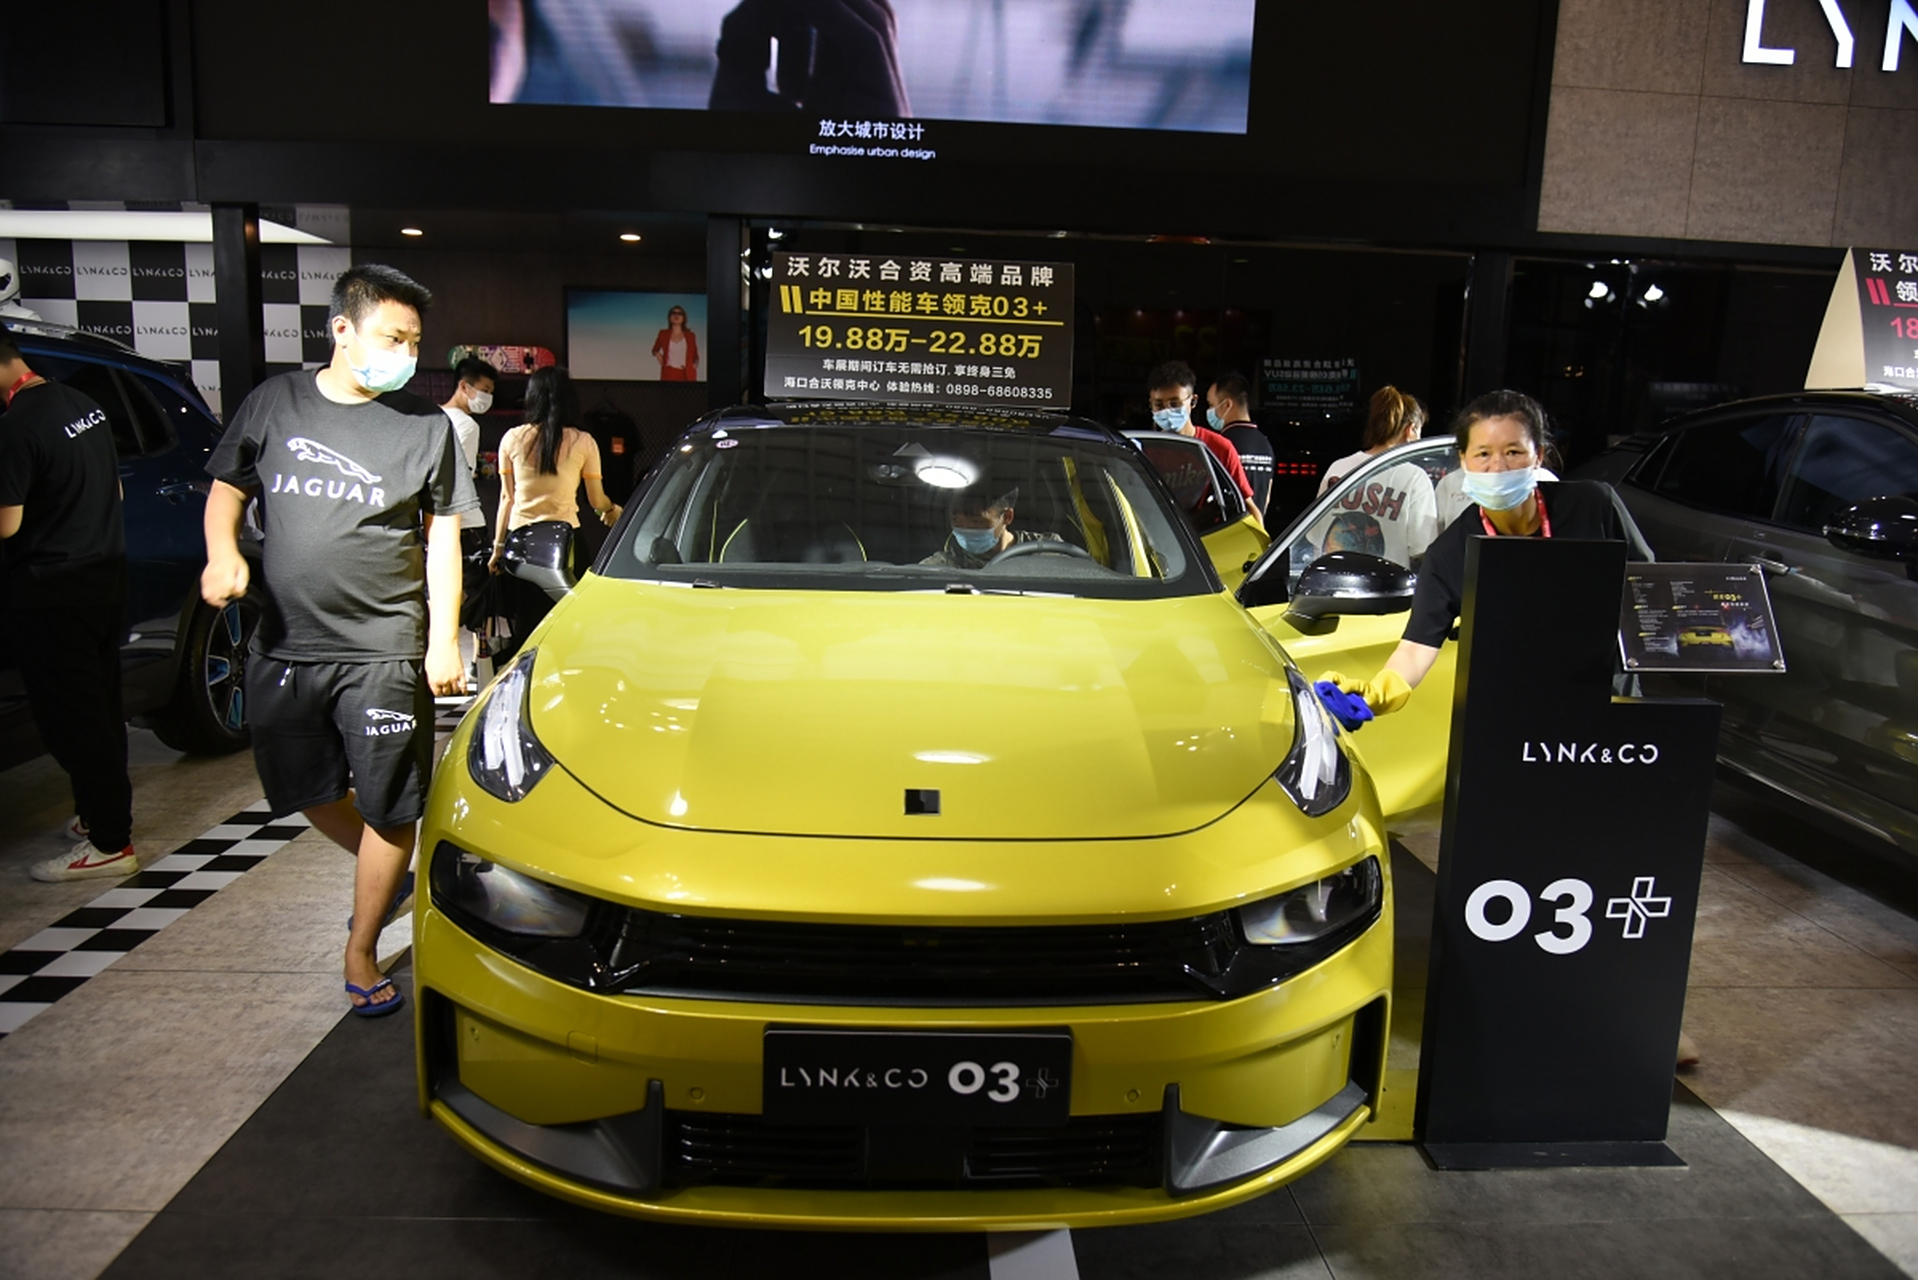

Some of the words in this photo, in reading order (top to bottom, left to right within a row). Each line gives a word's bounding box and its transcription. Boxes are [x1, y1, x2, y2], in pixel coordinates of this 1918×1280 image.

[819, 119, 925, 141] 放大城市设计
[809, 143, 865, 156] Emphasise
[867, 146, 899, 158] urban
[900, 148, 936, 160] design
[20, 264, 72, 275] LYNK&CO
[76, 266, 128, 276] LYNK&CO
[132, 268, 184, 278] LYNK&CO
[786, 256, 1055, 287] 沃尔沃合资高端品牌
[808, 287, 1048, 317] 中国性能车领克03+
[136, 325, 188, 336] LYNK&CO
[1882, 365, 1918, 378] 海口合
[271, 474, 385, 507] JAGUAR
[1522, 742, 1659, 764] LYNK&CO
[780, 1066, 929, 1089] LYNK&CO
